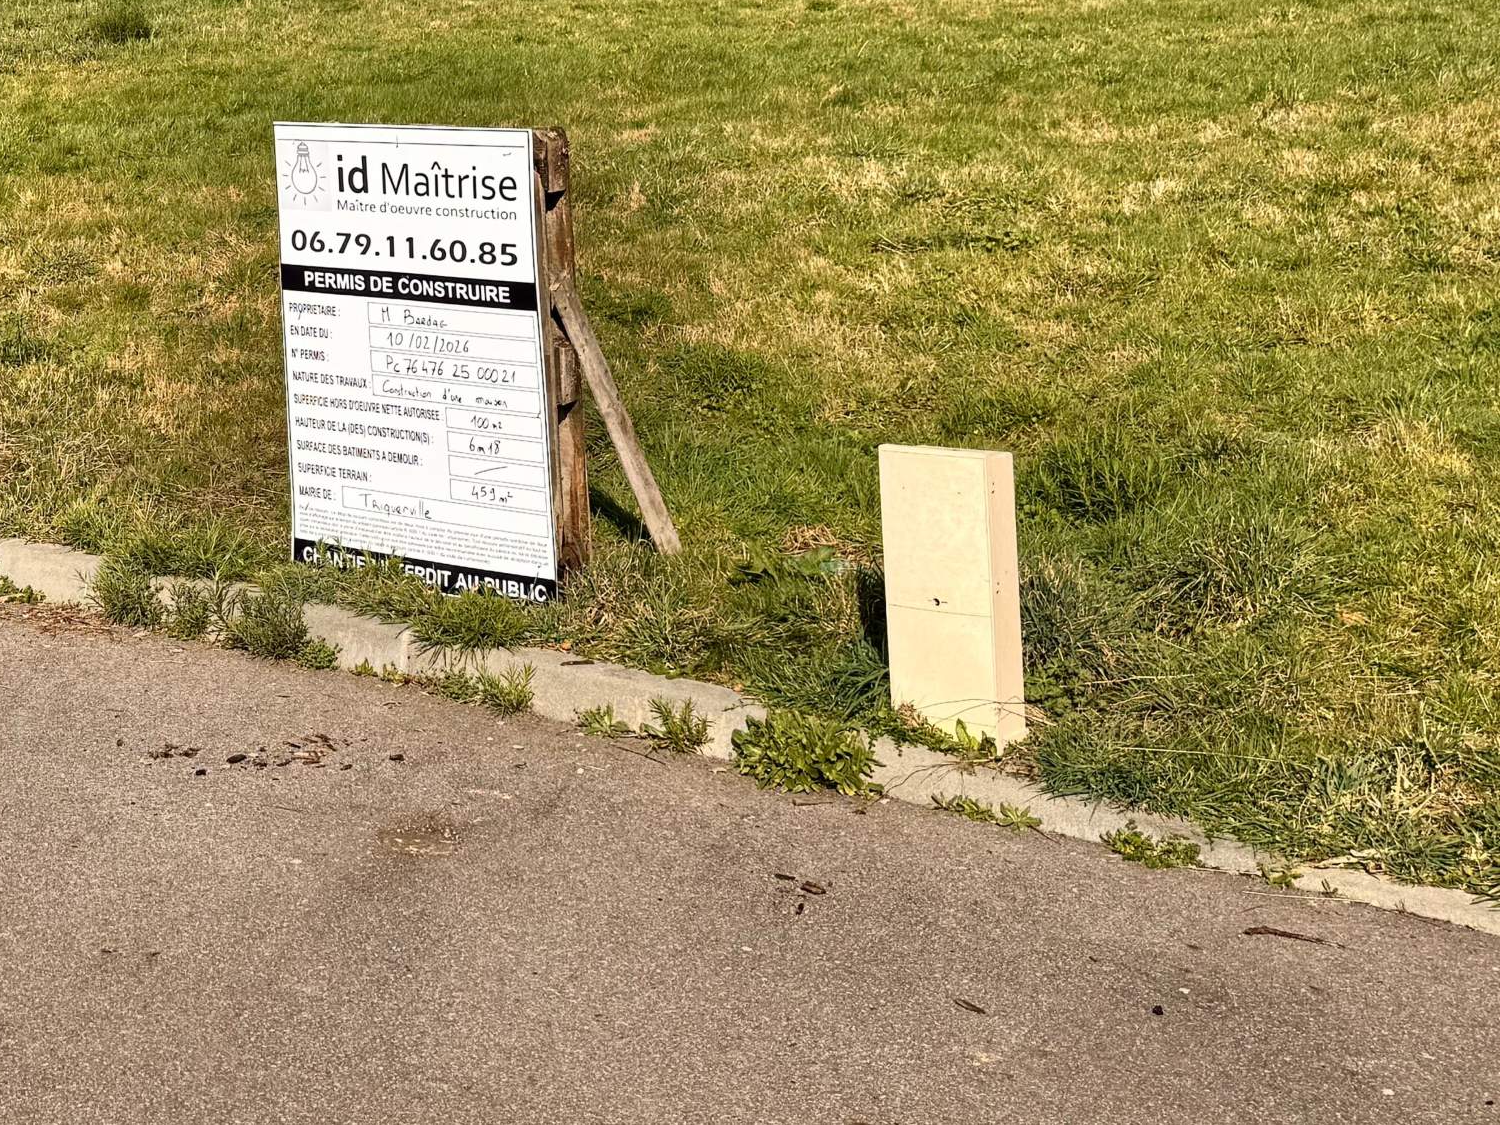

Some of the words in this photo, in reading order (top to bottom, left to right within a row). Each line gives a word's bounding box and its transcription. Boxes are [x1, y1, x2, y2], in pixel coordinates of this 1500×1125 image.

[337, 155, 368, 193] id
[382, 161, 517, 201] Maîtrise
[337, 200, 376, 213] Maître
[379, 201, 432, 216] d'oeuvre
[436, 205, 517, 221] construction
[291, 229, 518, 267] 06.79.11.60.85
[304, 271, 365, 293] PERMIS
[370, 275, 393, 295] DE
[399, 277, 510, 303] CONSTRUIRE
[290, 325, 299, 335] EN
[300, 326, 318, 337] DATE
[320, 327, 328, 339] DU
[300, 349, 325, 361] PERMIS
[292, 371, 318, 383] NATURE
[320, 373, 334, 385] DES
[336, 375, 368, 388] TRAVAUX
[452, 364, 470, 379] 25
[294, 393, 328, 407] SUPERFICIE
[330, 397, 347, 410] HORS
[382, 403, 402, 415] NETTE
[404, 406, 440, 421] AUTORISEE
[295, 416, 326, 429] HAUTEUR
[327, 420, 336, 431] DE
[338, 422, 346, 433] LA
[296, 439, 326, 453] SURFACE
[328, 443, 342, 455] DES
[342, 446, 380, 461] BATIMENTS
[382, 451, 386, 461] A
[388, 451, 419, 465] DEMOLIR
[298, 462, 336, 477] SUPERFICIE
[338, 467, 368, 481] TERRAIN
[299, 485, 321, 499] MAIRIE
[322, 489, 332, 501] DE
